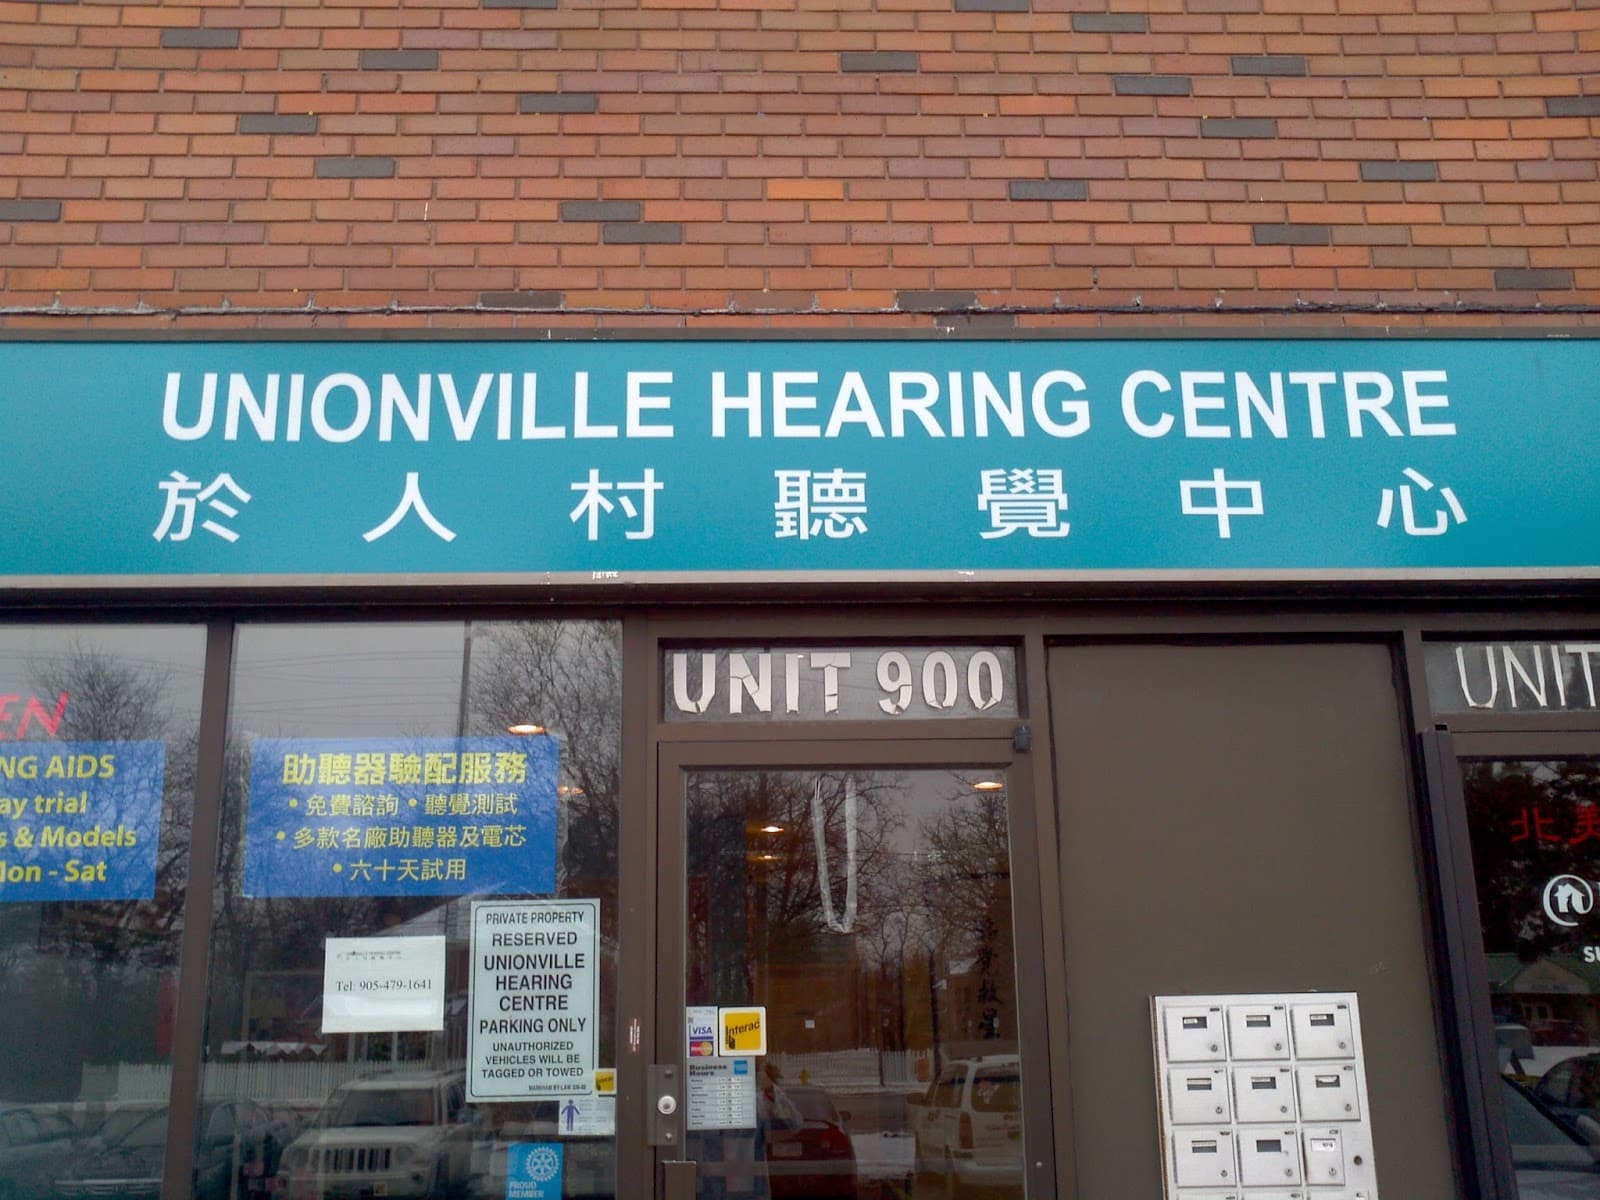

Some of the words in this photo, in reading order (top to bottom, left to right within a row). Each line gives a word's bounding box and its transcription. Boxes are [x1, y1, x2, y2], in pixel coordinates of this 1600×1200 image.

[162, 371, 674, 443] UNIONVILLE
[711, 370, 1091, 438] HEARING
[1121, 369, 1457, 438] CENTRE
[153, 467, 1468, 542] 於人村聽覺中心
[673, 652, 851, 714] UNIT
[876, 651, 1003, 715] 900
[1455, 644, 1600, 708] UNIT
[45, 754, 115, 779] AIDS
[281, 752, 527, 786] 助聽器驗配服務
[34, 791, 88, 814] trial
[424, 792, 518, 816] 聽覺測試
[14, 825, 34, 848] &
[40, 823, 137, 848] Models
[64, 859, 107, 882] Sat
[350, 858, 466, 882] 六十天試用
[486, 912, 528, 924] PRIVATE
[531, 911, 584, 923] PROPERTY
[492, 932, 577, 946] RESERVED
[484, 953, 585, 971] UNIONVILLE
[360, 979, 432, 992] 905-479-1641
[496, 974, 572, 991] HEARING
[500, 995, 568, 1011] CENTRE
[480, 1019, 543, 1034] PARKING
[548, 1018, 586, 1033] ONLY
[692, 1026, 712, 1035] VISA
[492, 1041, 574, 1052] UNAUTHORIZED
[485, 1055, 536, 1065] VEHICLES
[539, 1054, 564, 1064] WILL
[566, 1054, 581, 1063] BE
[482, 1068, 525, 1079] TAGGED
[528, 1068, 543, 1078] OR
[546, 1067, 584, 1077] TOWED
[509, 1181, 537, 1189] PROUD
[509, 1190, 545, 1198] MEMBER
